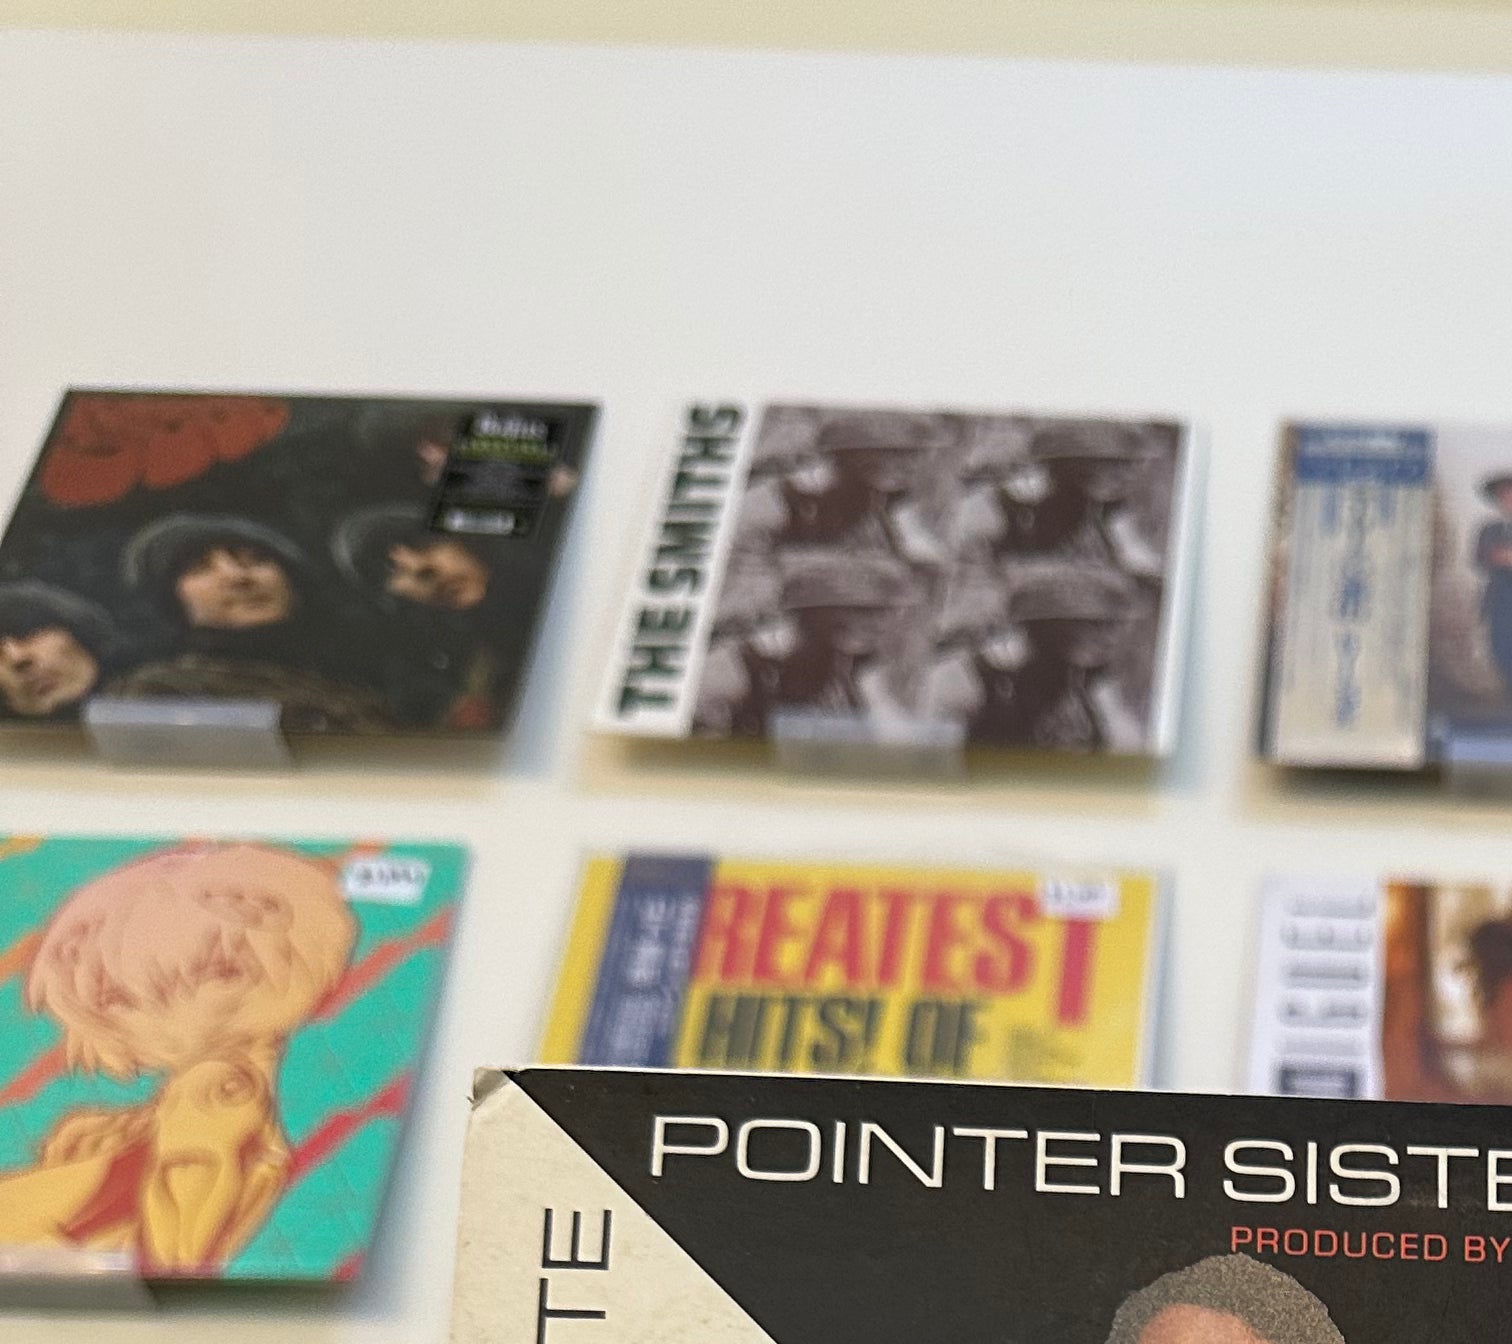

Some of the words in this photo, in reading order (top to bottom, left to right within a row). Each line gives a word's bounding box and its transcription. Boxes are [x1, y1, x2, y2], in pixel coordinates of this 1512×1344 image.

[645, 404, 742, 595] SMITHS
[616, 606, 693, 719] THE
[651, 1114, 1187, 1199] POINTER
[1231, 1226, 1449, 1263] PRODUCED
[1465, 1236, 1511, 1264] BY
